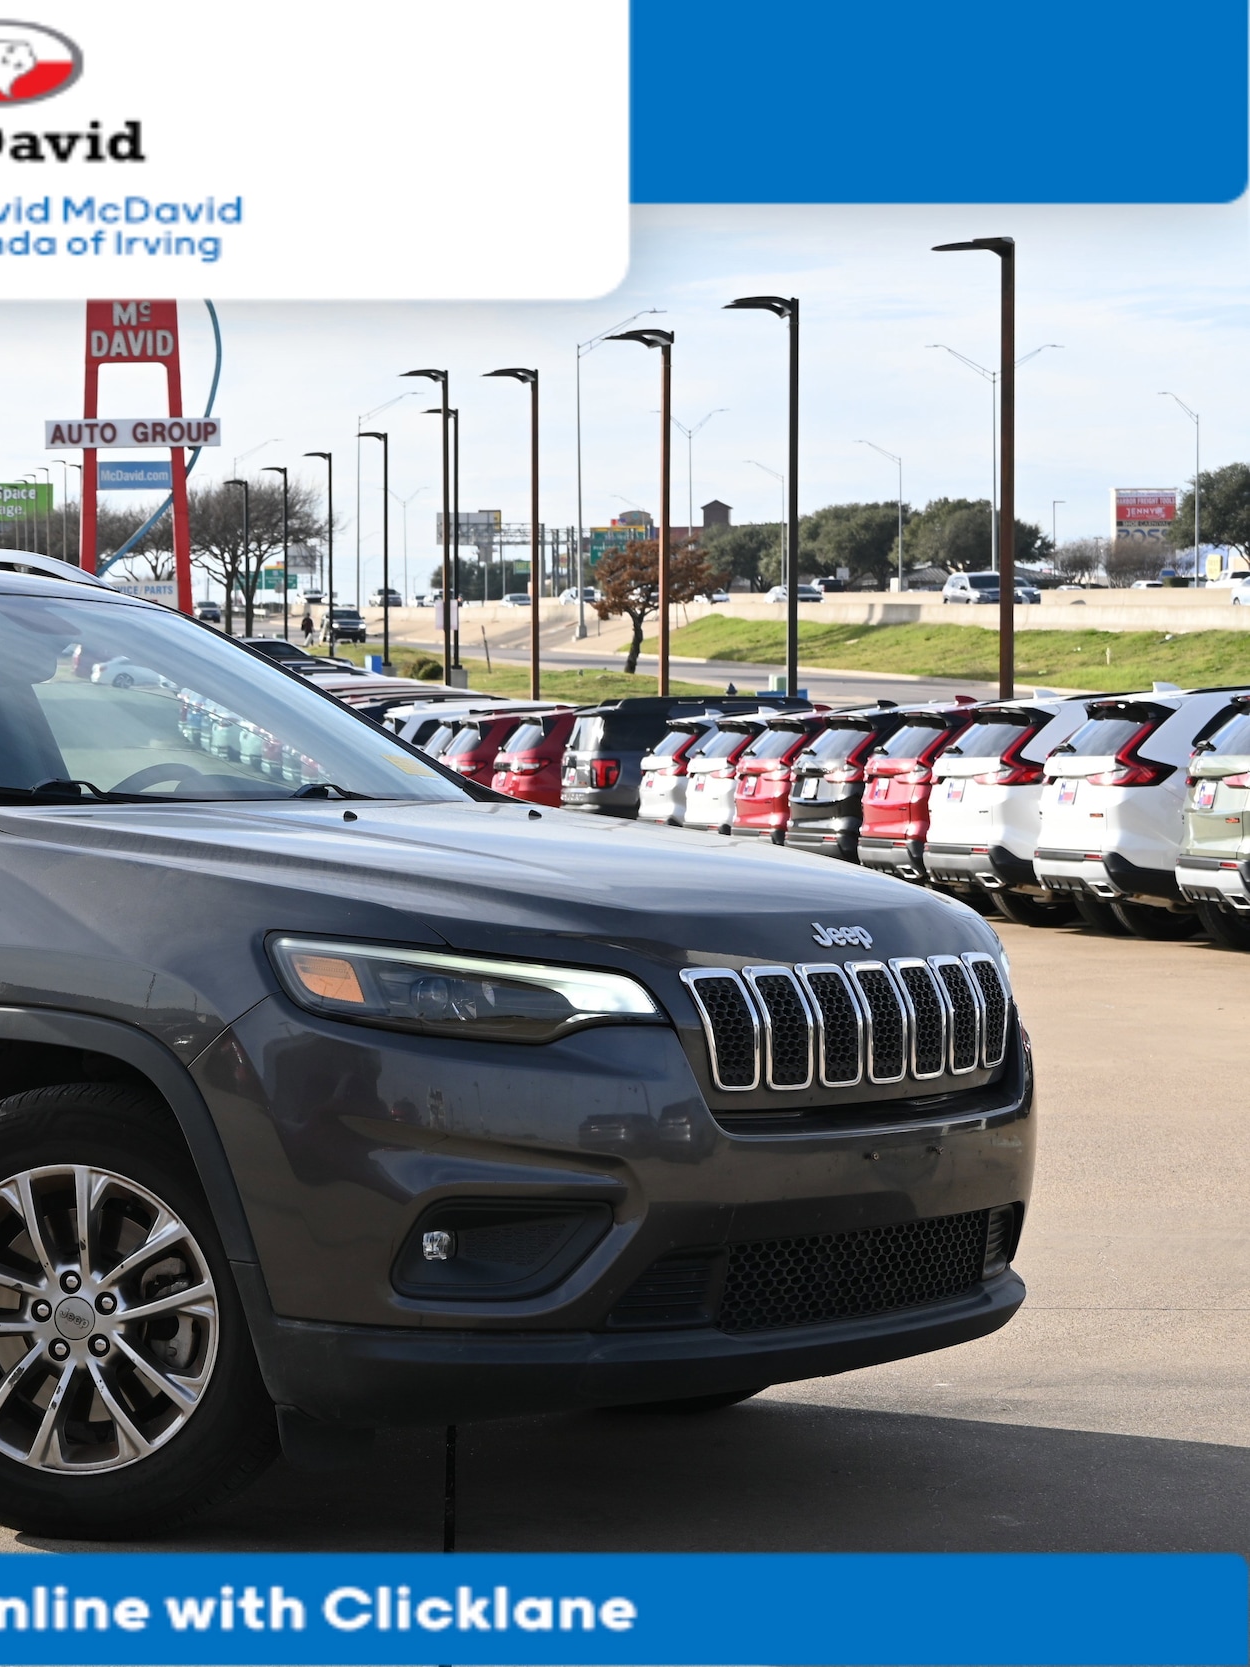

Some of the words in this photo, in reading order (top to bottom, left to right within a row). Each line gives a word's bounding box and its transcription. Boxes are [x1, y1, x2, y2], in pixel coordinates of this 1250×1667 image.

[90, 329, 174, 358] DAVID
[50, 422, 117, 444] AUTO
[132, 421, 217, 443] GROUP
[100, 469, 169, 482] McDavid.com
[115, 585, 173, 595] VICE/PARTS
[811, 922, 873, 950] Jeep
[59, 1308, 90, 1329] Jeep
